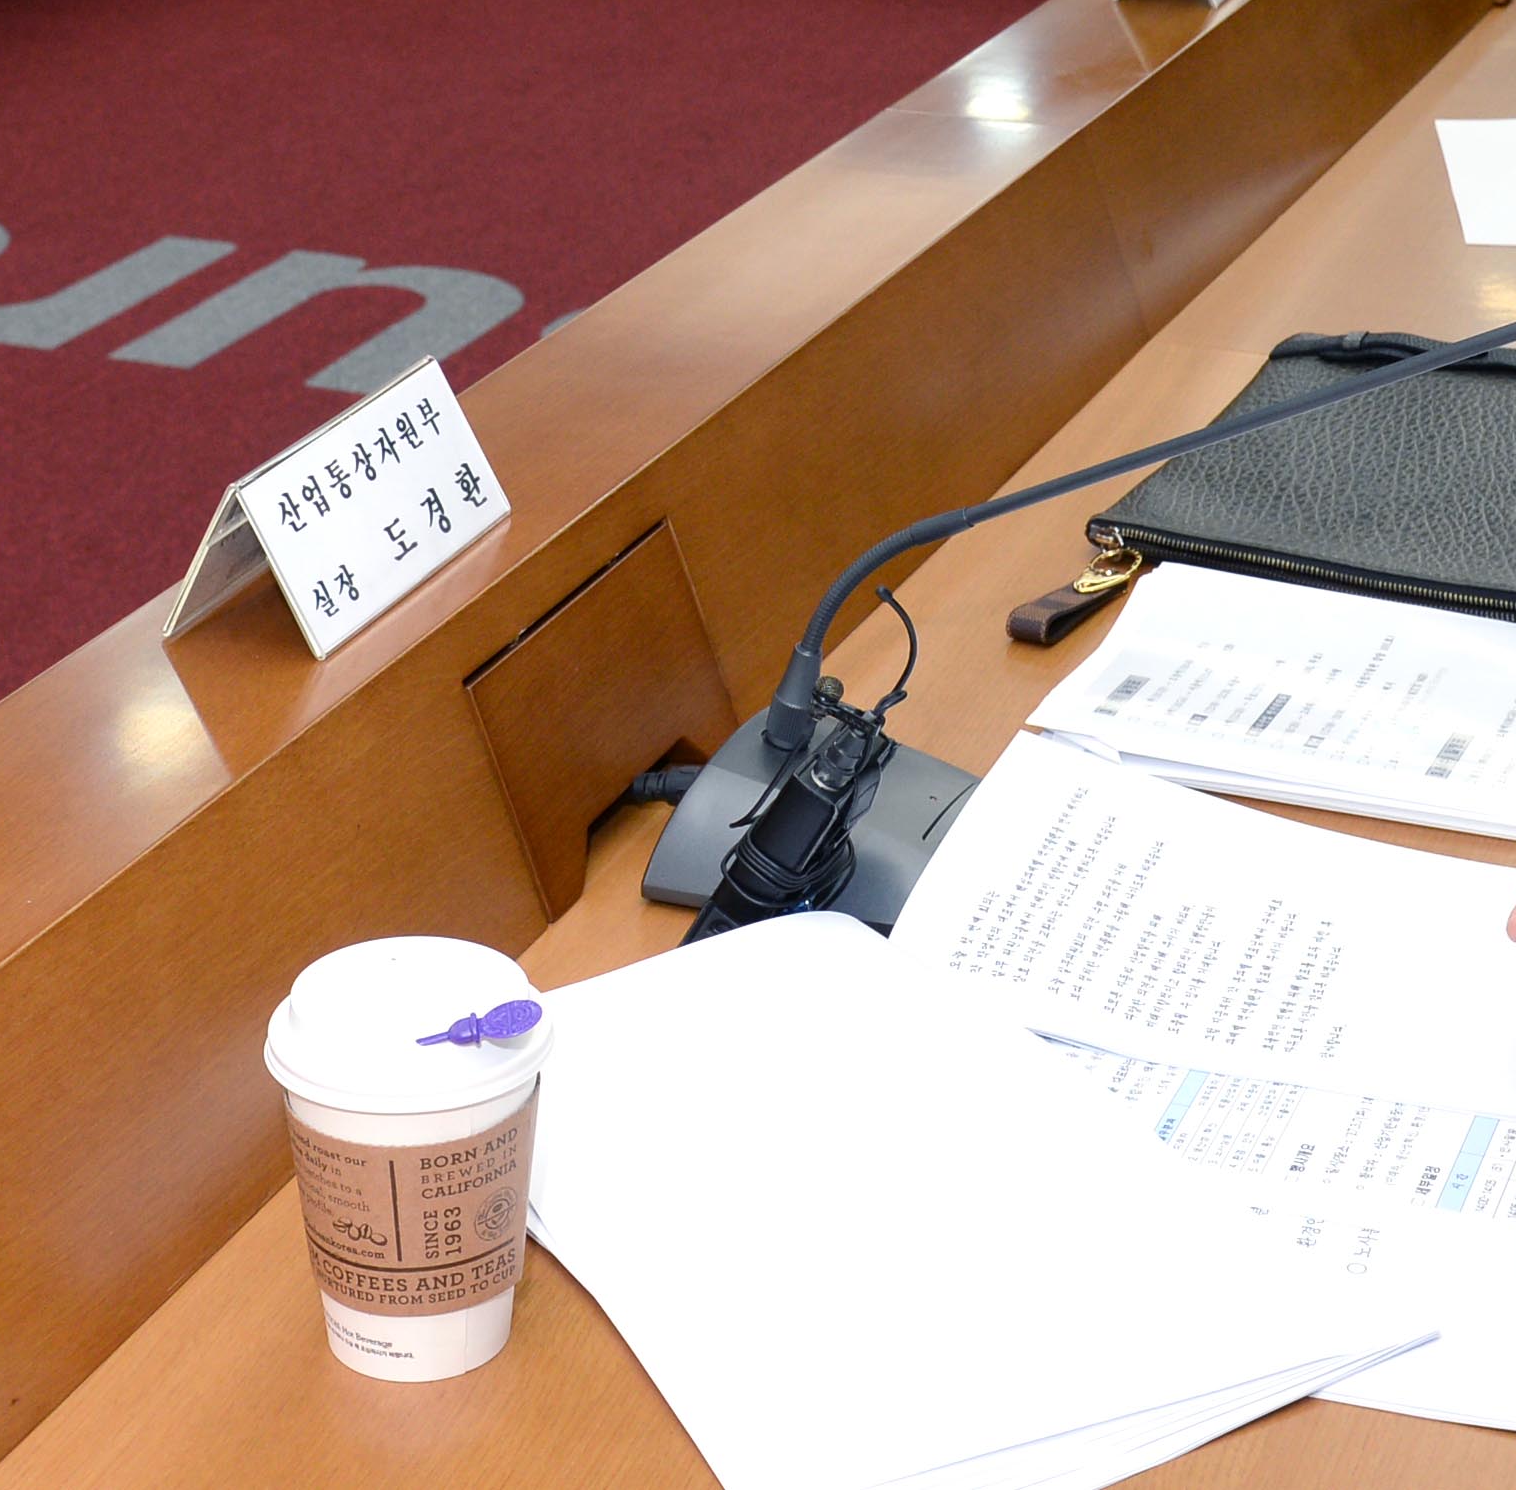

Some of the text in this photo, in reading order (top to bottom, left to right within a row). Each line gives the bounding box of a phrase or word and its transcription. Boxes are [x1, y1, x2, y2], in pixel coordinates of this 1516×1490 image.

[277, 398, 441, 533] 산업통상자원부
[312, 463, 488, 618] 실장 도 경 환
[345, 1156, 367, 1166] our
[420, 1128, 518, 1170] BORN AND
[421, 1145, 517, 1184] BREWED IN
[421, 1160, 517, 1200] CALIFORNIA
[424, 1210, 439, 1260] SINCE
[444, 1206, 462, 1256] 1963
[323, 1248, 516, 1292] COFFEES AND TEAS
[379, 1294, 423, 1305] FROM
[428, 1289, 466, 1304] SEED
[470, 1280, 489, 1294] TO
[492, 1264, 516, 1284] CUP
